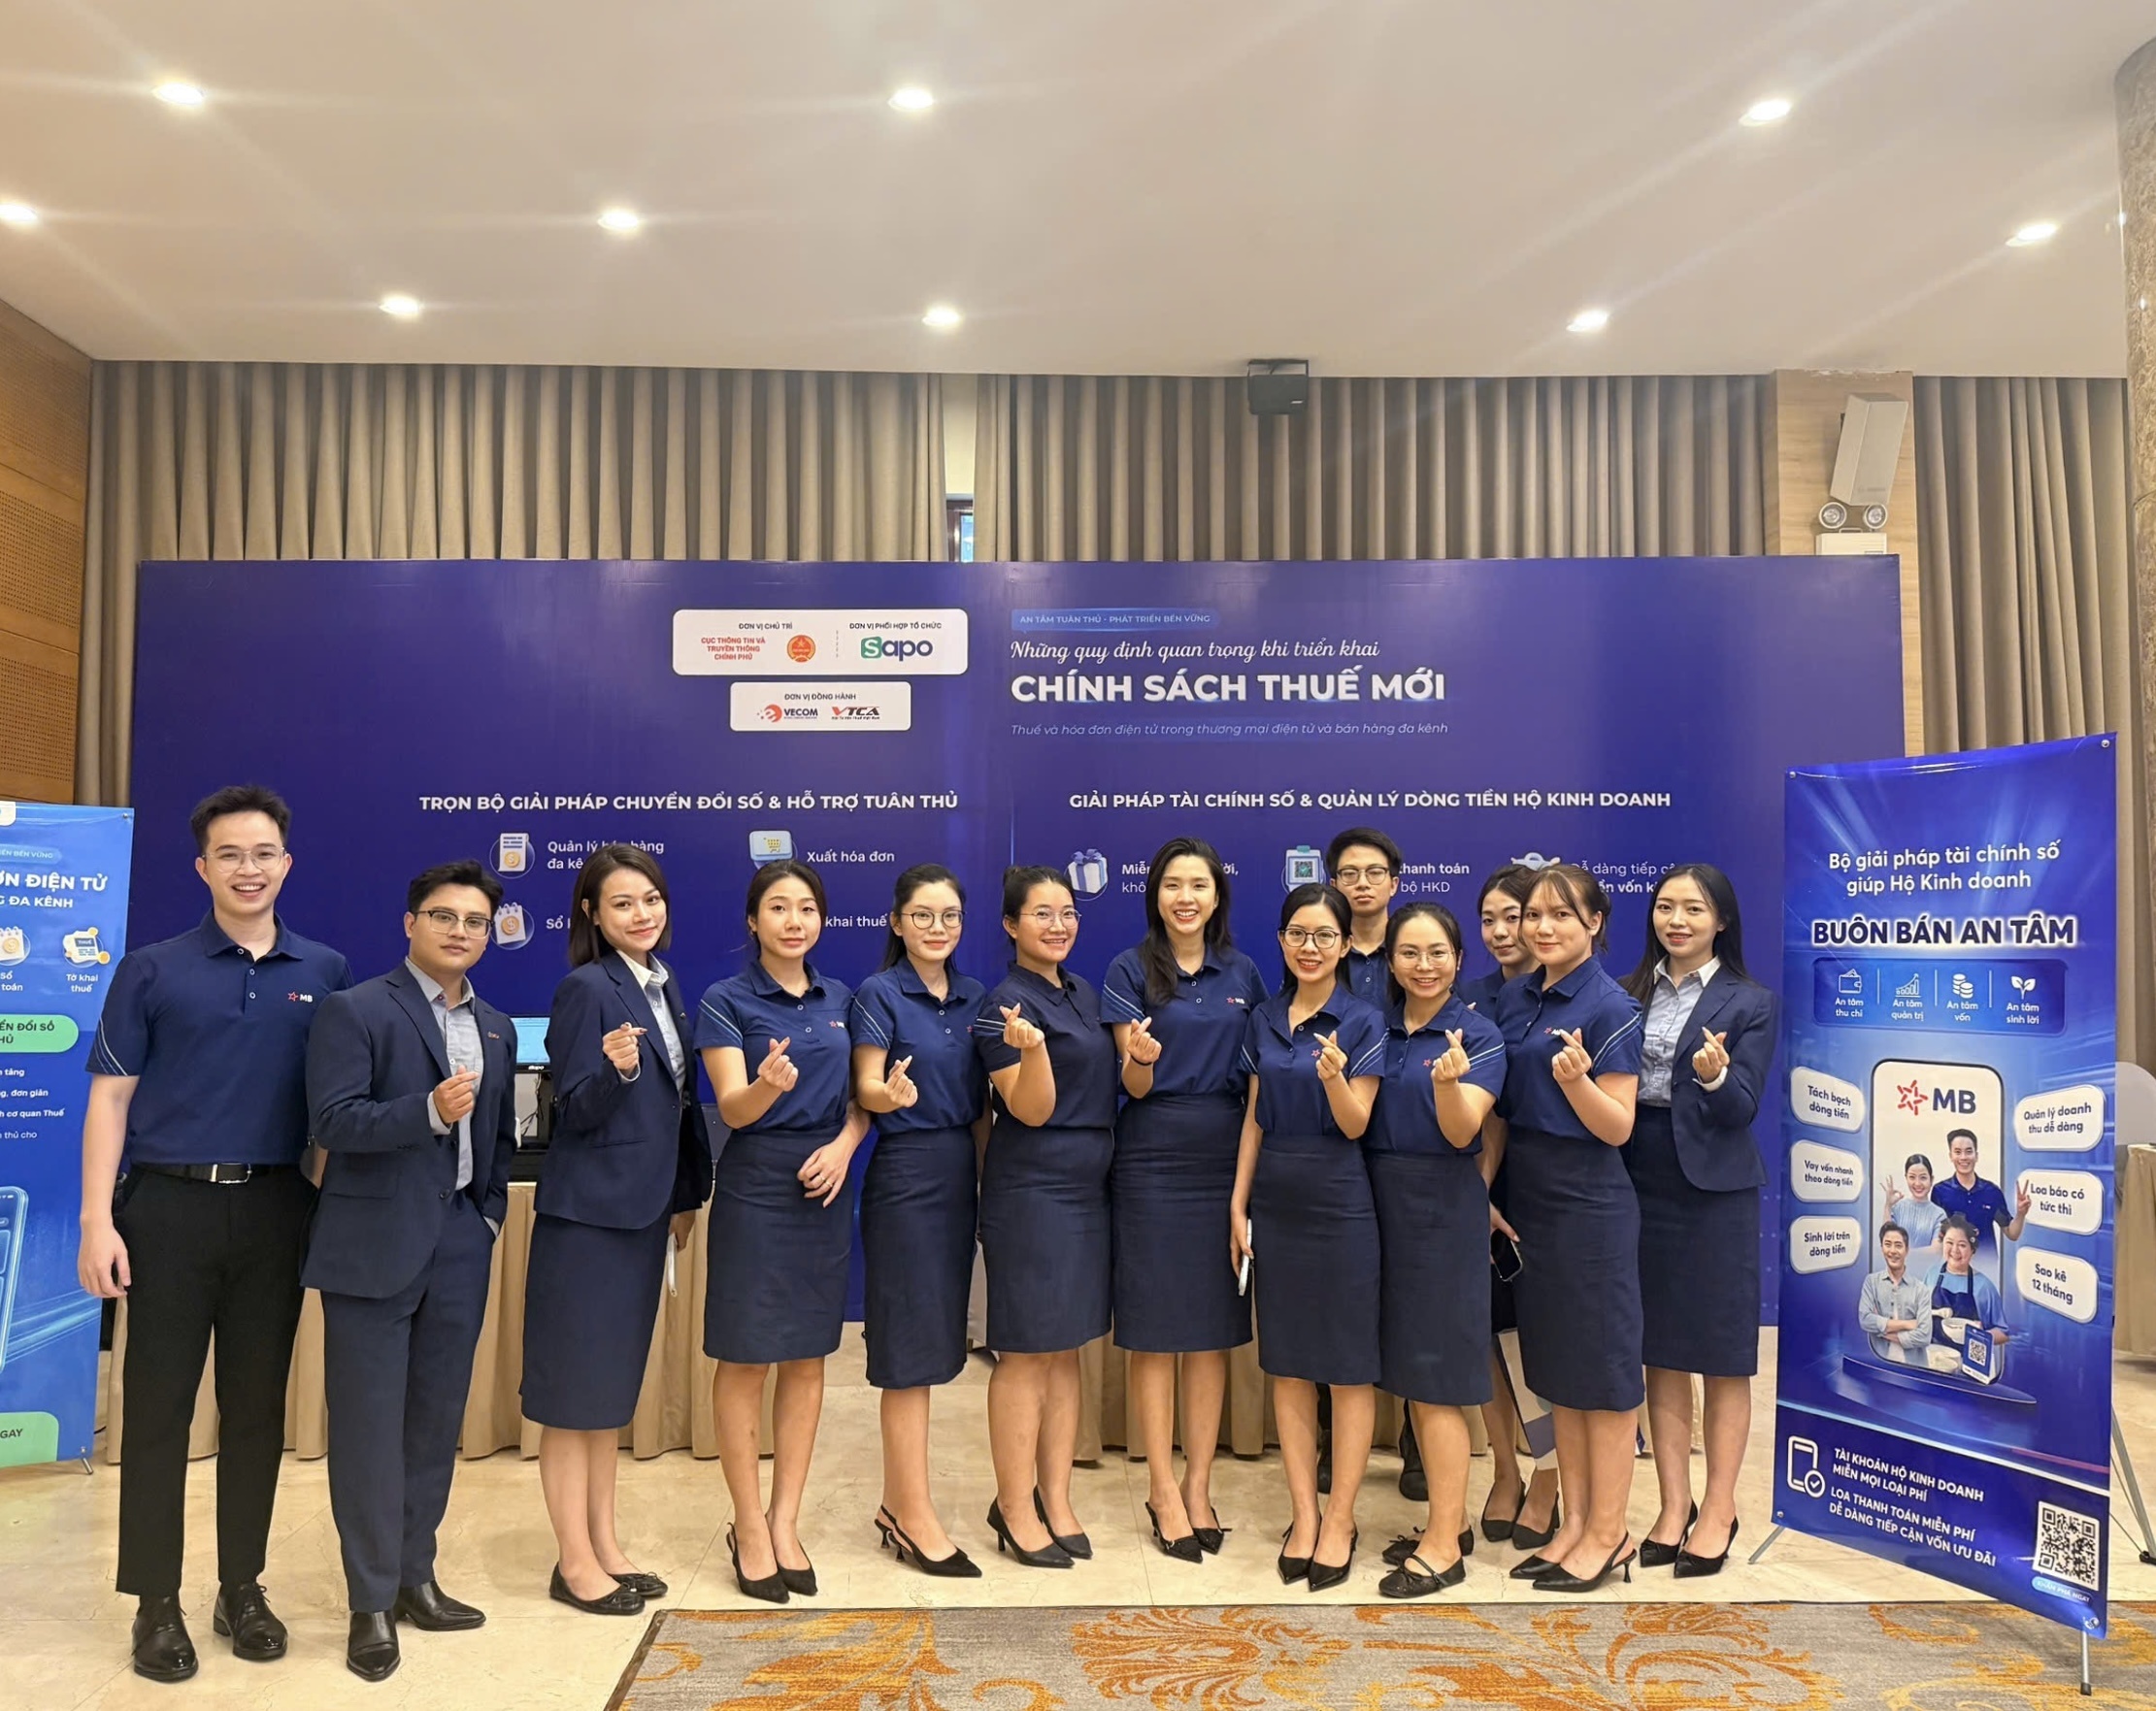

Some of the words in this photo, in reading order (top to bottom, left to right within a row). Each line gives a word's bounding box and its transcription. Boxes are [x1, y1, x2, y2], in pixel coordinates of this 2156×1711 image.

[1035, 614, 1055, 624] TÂM
[1057, 614, 1081, 624] TUÂN
[1082, 613, 1102, 623] THỦ
[1110, 614, 1133, 623] PHÁT
[1183, 613, 1211, 623] VỮNG
[1011, 641, 1070, 665] Những
[1074, 646, 1110, 665] quy
[1113, 641, 1154, 660] định
[1158, 646, 1204, 664] quan
[1209, 642, 1256, 664] trọng
[1261, 640, 1290, 657] khi
[1294, 637, 1336, 657] triển
[1339, 640, 1380, 657] khai
[1011, 669, 1132, 702] CHÍNH
[1144, 668, 1247, 702] SÁCH
[1257, 665, 1363, 702] THUẾ
[1372, 667, 1445, 702] MỚI
[832, 707, 879, 716] VTCA
[1011, 724, 1042, 735] Thuế
[1045, 725, 1059, 735] và
[1061, 724, 1085, 735] hóa
[1088, 724, 1111, 735] đơn
[1114, 724, 1142, 737] điện
[1144, 723, 1159, 735] tử
[1161, 725, 1194, 737] trong
[1197, 723, 1243, 737] thương
[1244, 723, 1270, 735] mại
[1272, 723, 1299, 736] điện
[1302, 722, 1316, 735] tử
[1317, 723, 1333, 735] và
[1335, 723, 1360, 734] bán
[1362, 723, 1395, 736] hàng
[1398, 723, 1415, 734] đa
[1417, 722, 1448, 734] kênh
[419, 796, 472, 813] TRỌN
[477, 794, 505, 813] BỘ
[510, 792, 547, 810] GIẢI
[554, 792, 609, 810] PHÁP
[613, 791, 692, 810] CHUYỂN
[697, 791, 732, 809] ĐỔI
[737, 791, 764, 809] SỐ
[769, 795, 781, 809] &
[787, 790, 815, 809] HỖ
[820, 794, 859, 812] TRỢ
[864, 792, 914, 809] TUÂN
[920, 790, 958, 809] THỦ
[1070, 790, 1107, 807] GIẢI
[1113, 791, 1165, 807] PHÁP
[1170, 791, 1199, 807] TÀI
[1204, 791, 1264, 807] CHÍNH
[1270, 789, 1295, 807] SỐ
[1300, 794, 1312, 807] &
[1317, 789, 1373, 809] QUẢN
[1378, 790, 1399, 807] LÝ
[1405, 791, 1460, 807] DÒNG
[1465, 788, 1508, 806] TIỀN
[1513, 789, 1542, 809] HỘ
[1547, 793, 1594, 806] KINH
[1600, 793, 1671, 806] DOANH
[547, 840, 583, 853] Quản
[807, 848, 838, 863] Xuất
[841, 849, 866, 863] hóa
[869, 849, 895, 863] đơn
[1829, 852, 1851, 873] Bộ
[1855, 850, 1888, 872] giải
[1894, 848, 1940, 871] pháp
[1945, 846, 1971, 865] tài
[1975, 842, 2031, 863] chính
[2037, 839, 2062, 860] số
[547, 858, 565, 871] đa
[1439, 863, 1470, 874] toán
[1593, 862, 1627, 877] dàng
[1631, 861, 1657, 877] tiếp
[25, 872, 75, 893] ĐIỆN
[81, 872, 109, 892] TỬ
[1401, 880, 1418, 895] bộ
[1421, 881, 1450, 893] HKD
[1617, 879, 1643, 893] vốn
[1846, 875, 1885, 897] giúp
[1890, 874, 1915, 896] Hộ
[1920, 872, 1962, 891] Kinh
[1968, 870, 2032, 889] doanh
[9, 895, 30, 906] ĐA
[34, 895, 74, 908] KÊNH
[546, 914, 564, 930] Sổ
[825, 915, 853, 928] khai
[856, 912, 888, 927] thuế
[1813, 916, 1888, 944] BUÔN
[1896, 915, 1953, 944] BÁN
[1960, 920, 2001, 944] AN
[2009, 913, 2074, 944] TÂM
[79, 973, 99, 982] khai
[1, 983, 23, 992] toán
[300, 994, 314, 1003] MB
[1835, 997, 1846, 1005] An
[1847, 998, 1864, 1006] tâm
[1946, 1001, 1959, 1009] An
[1961, 1002, 1978, 1010] tâm
[1836, 1008, 1849, 1017] thu
[1850, 1008, 1863, 1017] chi
[1954, 1012, 1971, 1021] vốn
[1808, 1085, 1829, 1101] Tách
[1933, 1088, 1976, 1115] MB
[2047, 1106, 2056, 1120] lý
[2058, 1102, 2092, 1117] doanh
[2028, 1124, 2041, 1134] thu
[2057, 1120, 2083, 1134] dàng
[2031, 1183, 2047, 1195] Loa
[2049, 1185, 2069, 1198] báo
[2071, 1188, 2085, 1200] có
[2040, 1201, 2056, 1212] tức
[2035, 1263, 2052, 1277] Sao
[2054, 1268, 2067, 1282] kê
[2032, 1278, 2041, 1291] 12
[2042, 1282, 2073, 1305] tháng
[1835, 1448, 1850, 1462] TÀI
[1891, 1464, 1907, 1481] HỘ
[1908, 1470, 1936, 1488] KINH
[1938, 1479, 1984, 1502] DOANH
[1860, 1472, 1880, 1489] MỌI
[1883, 1480, 1907, 1497] LOẠI
[1908, 1489, 1928, 1502] PHÍ
[1831, 1486, 1850, 1502] LOA
[1853, 1493, 1888, 1515] THANH
[1890, 1505, 1920, 1525] TOÁN
[1922, 1515, 1951, 1534] MIỄN
[1953, 1527, 1976, 1542] PHÍ
[1844, 1506, 1874, 1527] DÀNG
[1875, 1517, 1899, 1533] TIẾP
[1900, 1527, 1924, 1543] CẬN
[1926, 1535, 1951, 1553] VỐN
[1953, 1544, 1973, 1560] ƯU
[1974, 1550, 1997, 1567] ĐÃI
